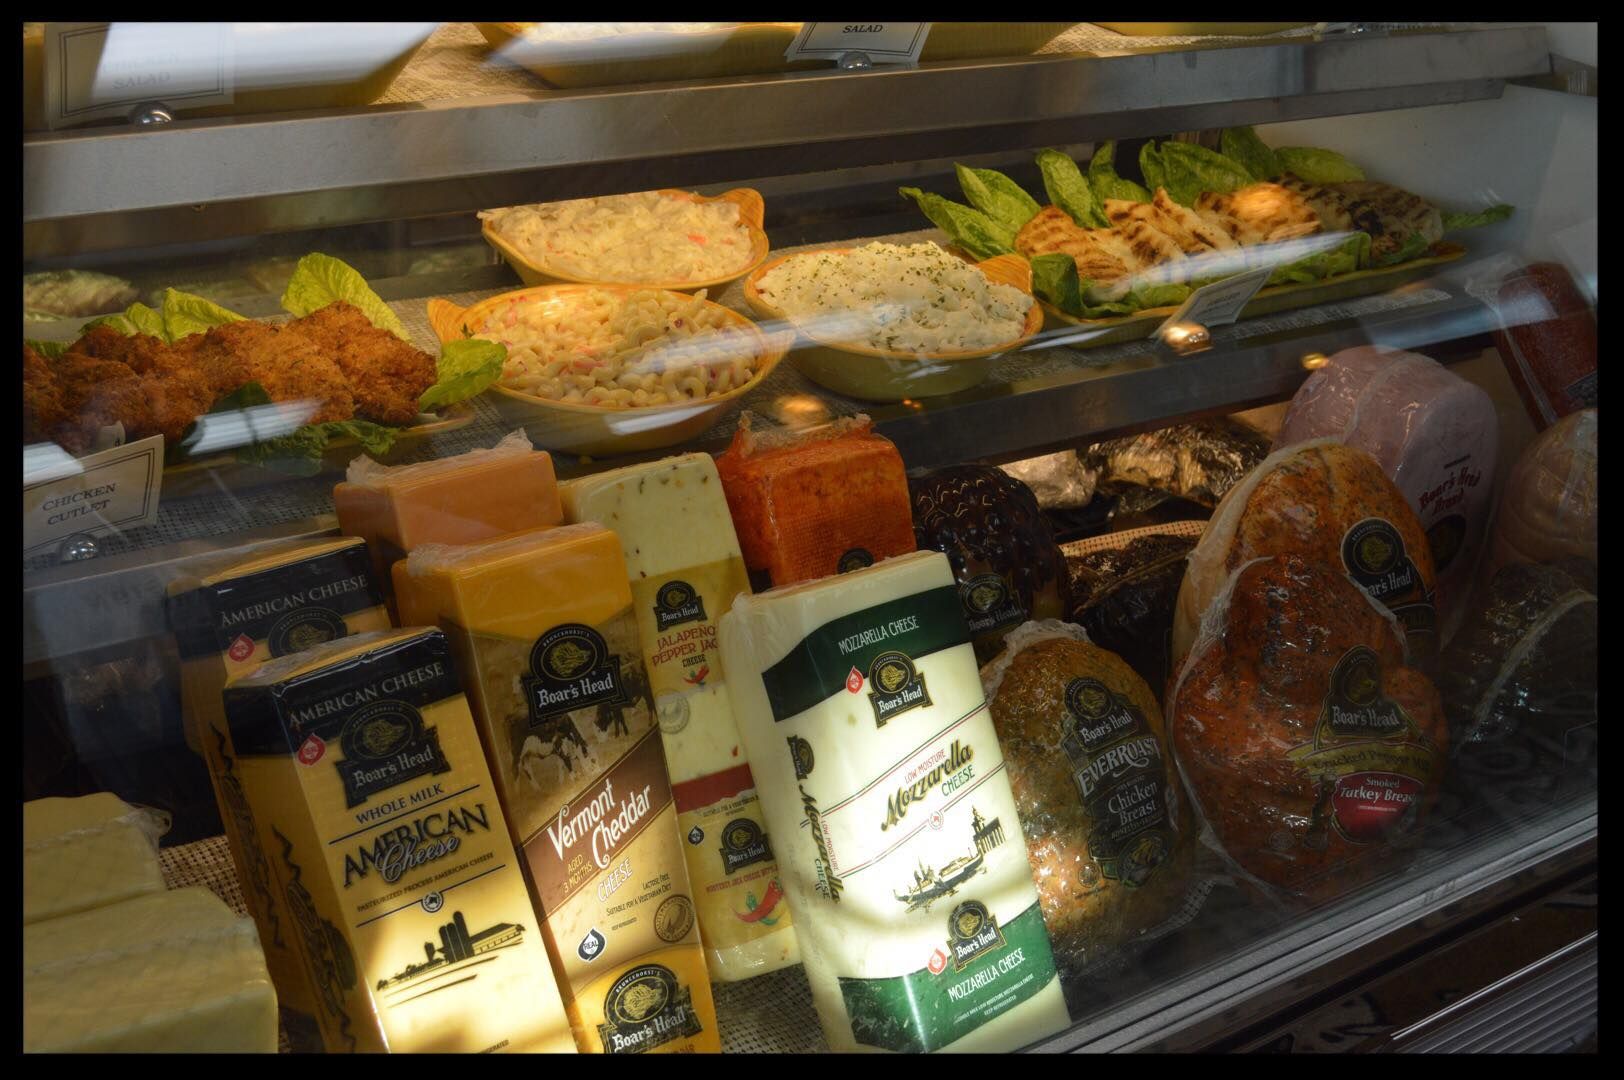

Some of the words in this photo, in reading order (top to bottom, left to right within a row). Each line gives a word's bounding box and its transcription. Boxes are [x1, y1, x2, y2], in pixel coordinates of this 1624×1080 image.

[842, 24, 884, 34] SALAD
[42, 482, 117, 511] CHICKEN
[47, 499, 112, 526] CUTLET
[1367, 578, 1389, 597] ar's
[1387, 566, 1413, 590] Head
[220, 591, 306, 628] AMERICAN
[308, 574, 370, 602] CHEESE
[657, 625, 717, 653] JALAPEÑO
[838, 625, 890, 656] MOZZARELLA
[888, 615, 920, 637] CHEESE
[652, 642, 697, 667] PEPPER
[288, 683, 379, 726] AMERICAN
[381, 661, 445, 696] CHEESE
[537, 683, 580, 709] Boar's
[579, 672, 614, 697] Head
[877, 694, 903, 713] Boar's
[902, 684, 923, 704] Head
[1079, 723, 1113, 743] Boar's
[1108, 709, 1134, 730] Head
[1331, 705, 1368, 727] Boar's
[1367, 708, 1400, 727] Head
[353, 761, 398, 788] Boar's
[396, 743, 435, 771] Head
[904, 770, 918, 785] LOW
[917, 749, 947, 776] MOISTURE
[941, 764, 976, 797] CHEESE
[1077, 735, 1161, 798] EVERROAST
[1366, 776, 1400, 788] Smoked
[880, 739, 975, 832] Mozzarella
[1107, 781, 1159, 814] Chicken
[1339, 786, 1382, 804] Turkey
[355, 798, 408, 825] WHOLE
[410, 783, 445, 806] MILK
[546, 777, 616, 861] Vermont
[1119, 800, 1157, 826] Breast
[591, 784, 650, 869] Cheddar
[343, 802, 491, 889] AMERICAN
[374, 835, 460, 883] Cheese
[434, 862, 470, 882] AMERICAN
[563, 882, 570, 894] 3
[569, 860, 593, 890] MONTHS
[567, 854, 584, 875] AGED
[597, 858, 634, 902] CHEESE
[583, 940, 599, 951] REAL
[955, 940, 980, 960] Boar's
[978, 927, 997, 946] Head
[947, 965, 1000, 1003] MOZZARELLA
[998, 947, 1026, 975] CHEESE
[611, 1024, 655, 1053] Boar's
[653, 1005, 687, 1033] Head
